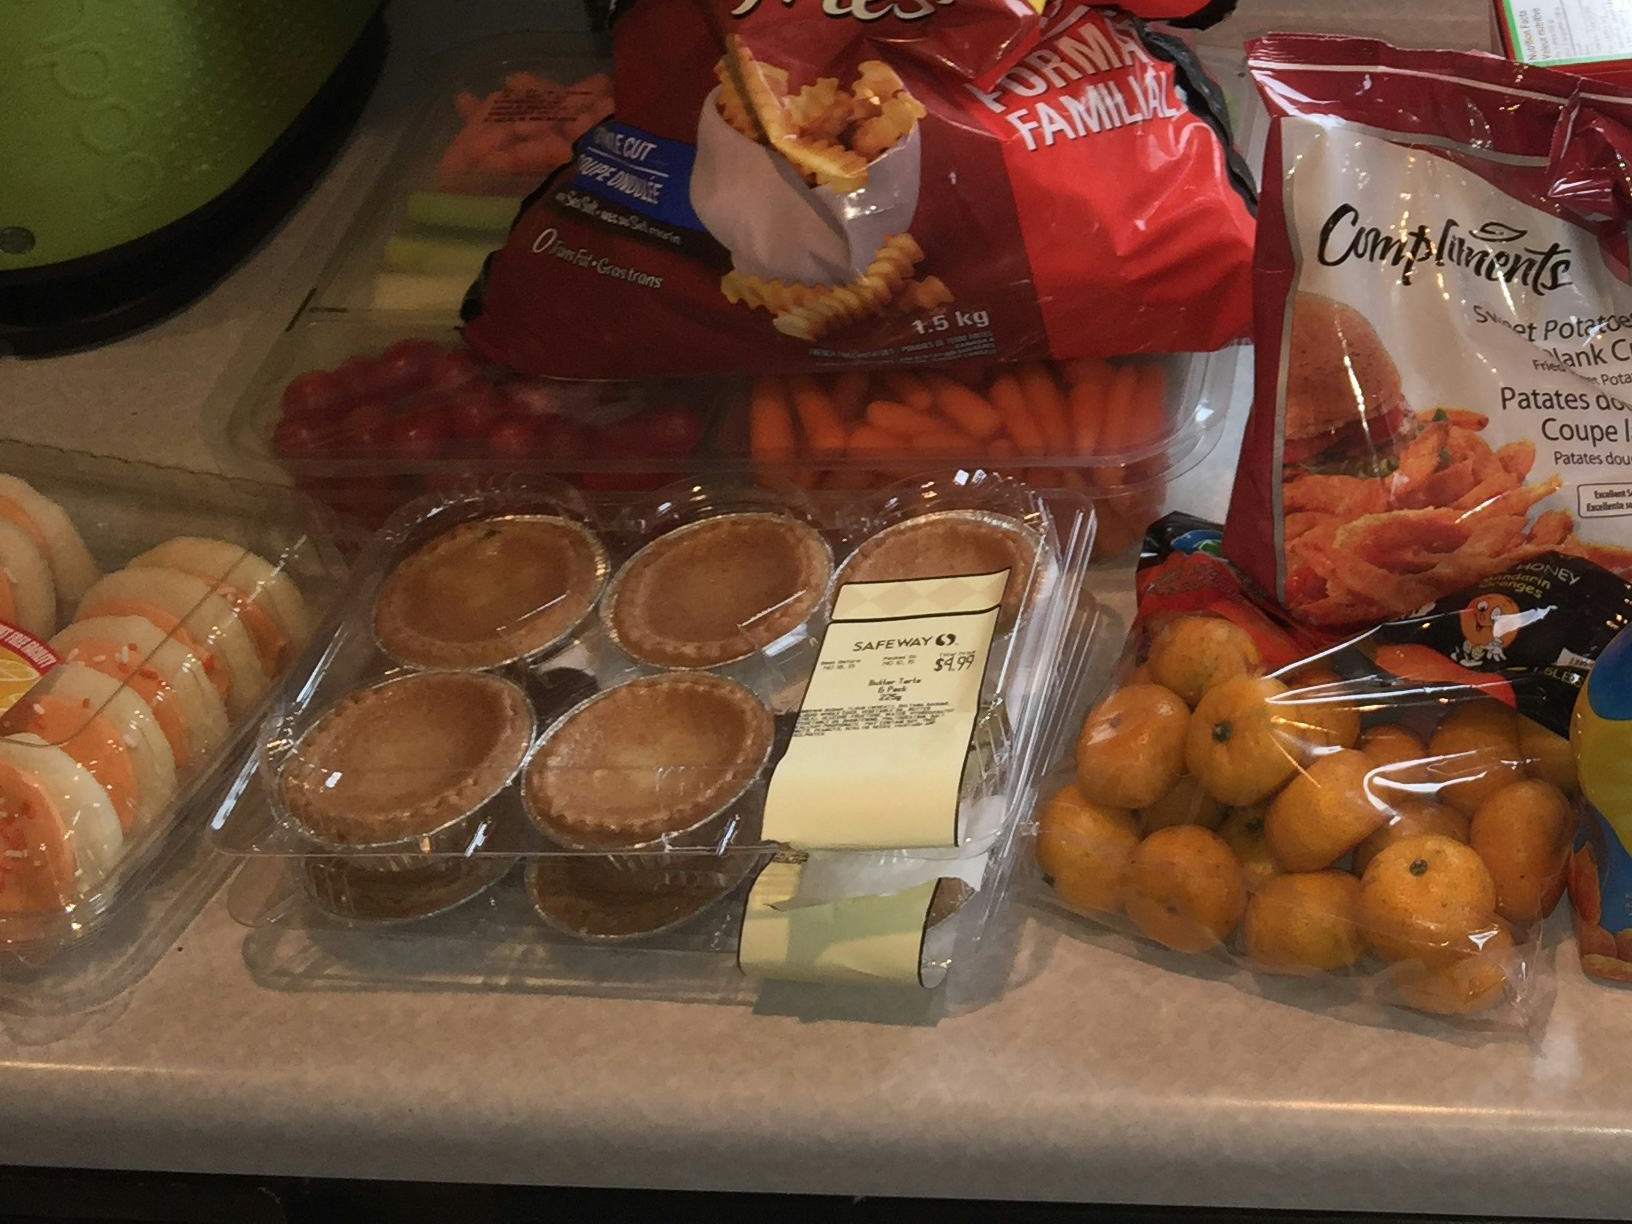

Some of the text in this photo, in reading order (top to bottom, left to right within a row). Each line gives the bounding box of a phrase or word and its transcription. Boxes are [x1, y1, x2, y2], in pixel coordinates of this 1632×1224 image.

[1004, 70, 1188, 152] FAMILIAL
[623, 136, 658, 162] CUT
[531, 228, 558, 254] 0
[626, 266, 664, 290] trans
[1317, 202, 1573, 296] Compliments
[911, 309, 991, 335] 1.5 kg
[1473, 304, 1537, 343] Swet
[1500, 386, 1590, 411] Patates
[1541, 417, 1619, 448] Coupe
[1553, 451, 1603, 466] Patates
[1593, 487, 1626, 499] Excellent
[1586, 501, 1625, 513] Excellente
[1516, 562, 1581, 585] HONEY
[853, 635, 934, 652] SAFEWAY
[933, 654, 976, 673] $4.99
[867, 677, 922, 687] Butter Tarts
[886, 685, 908, 693] Pack
